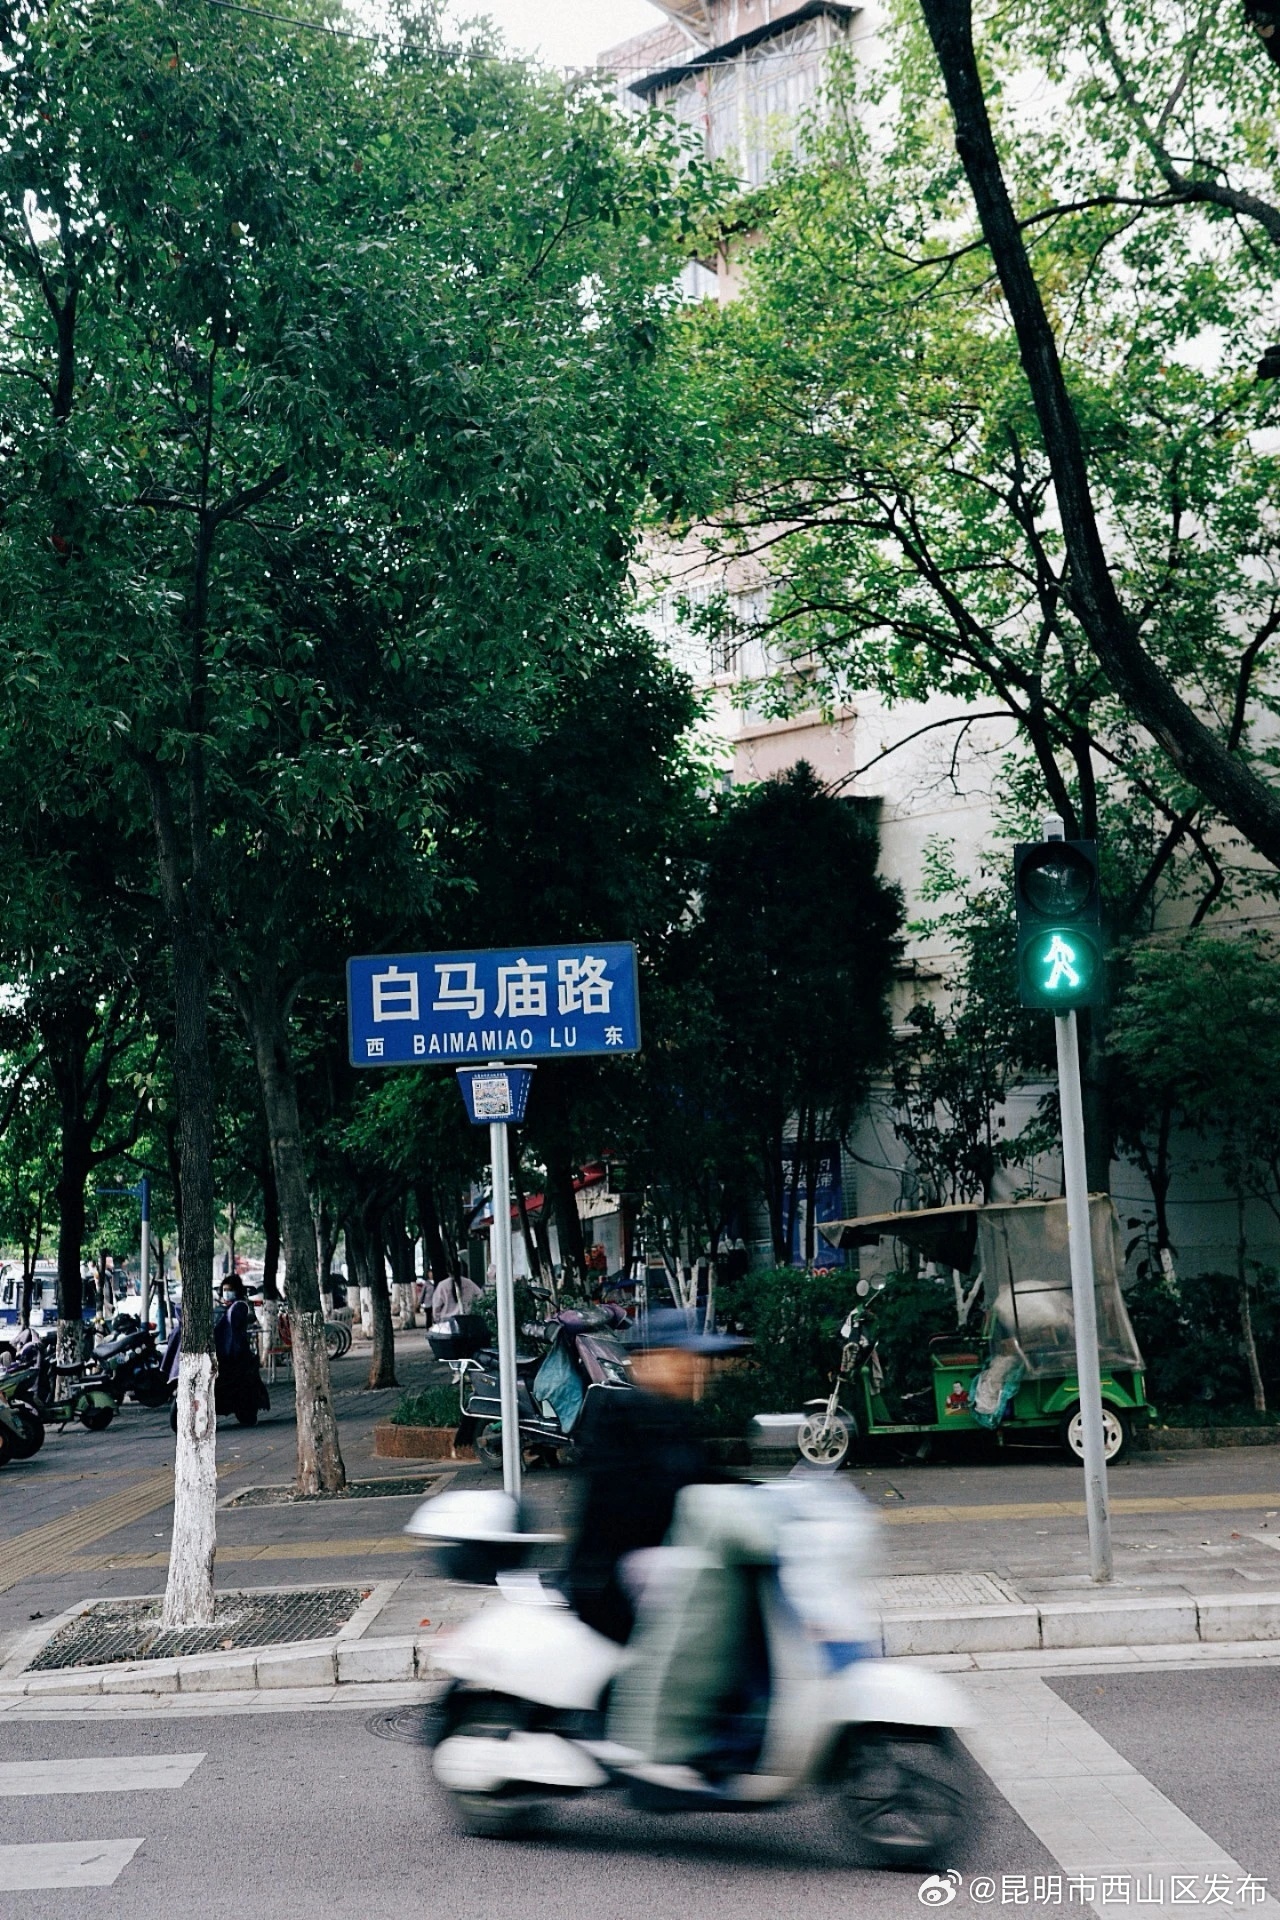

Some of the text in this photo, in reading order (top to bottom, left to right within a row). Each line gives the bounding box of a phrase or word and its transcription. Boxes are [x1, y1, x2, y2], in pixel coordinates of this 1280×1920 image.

[371, 955, 614, 1023] 白马庙路
[366, 1037, 384, 1057] 西
[413, 1026, 577, 1055] BAIMAMIAO LU
[605, 1026, 623, 1045] 东
